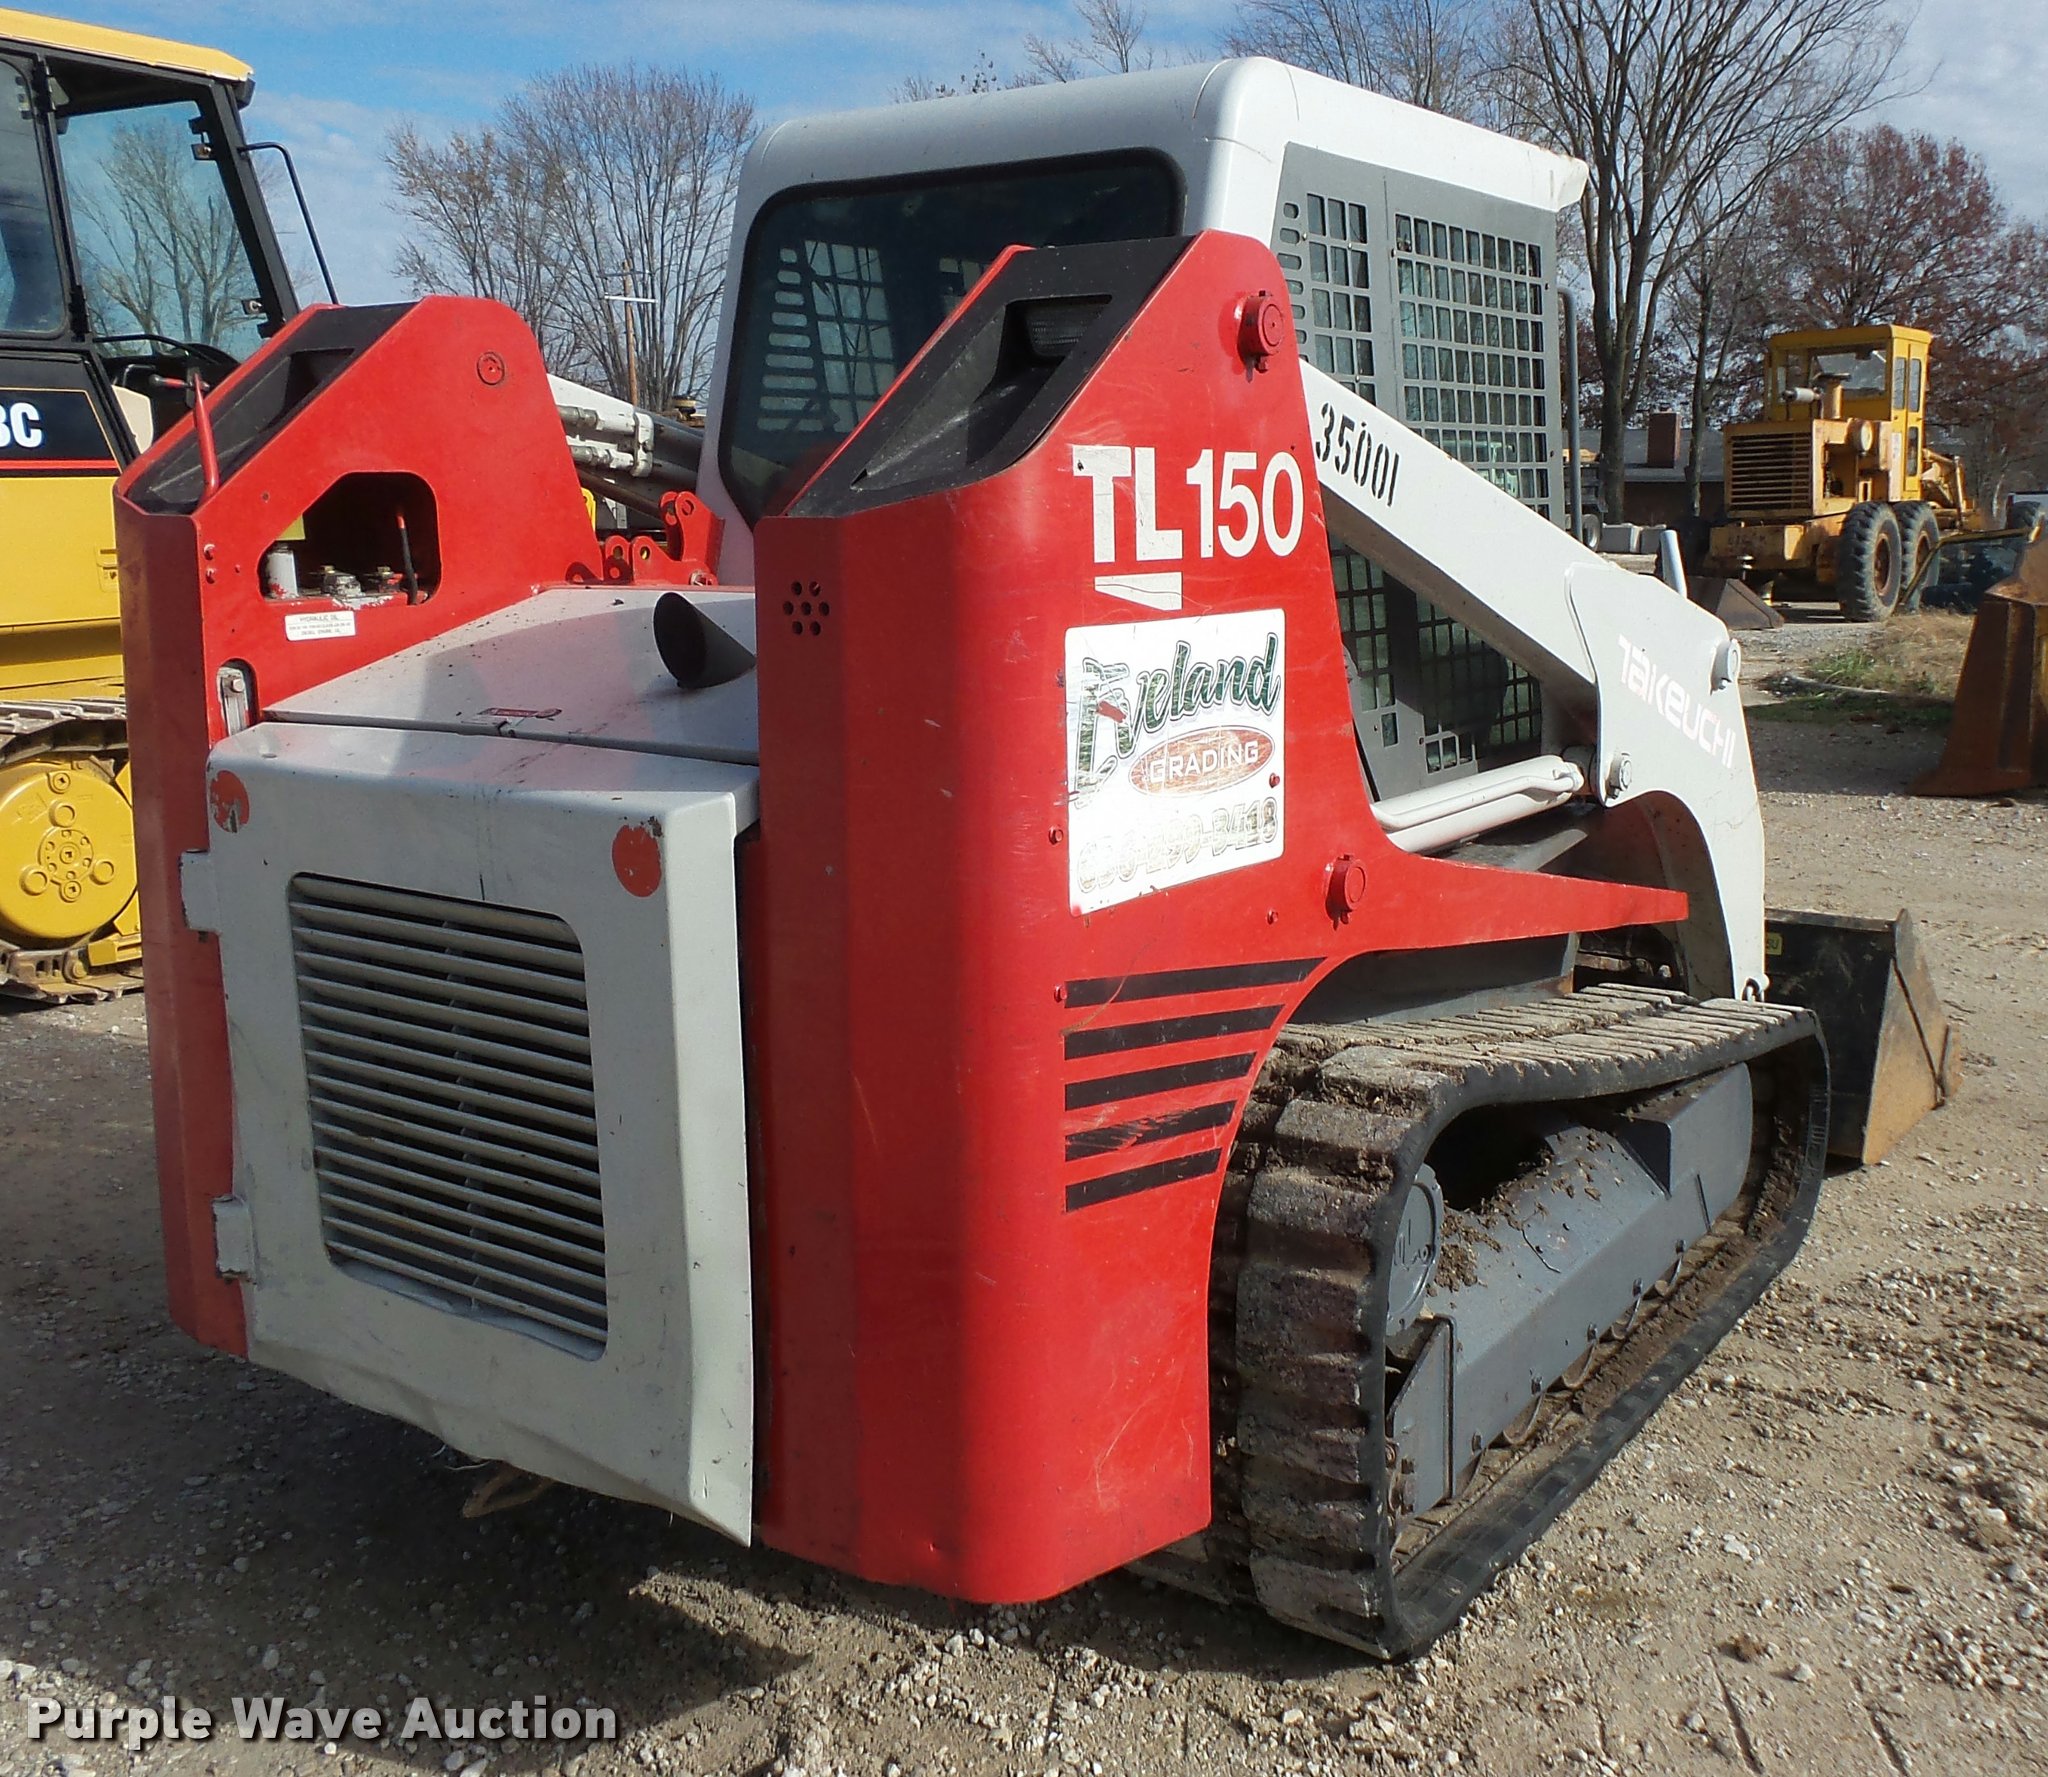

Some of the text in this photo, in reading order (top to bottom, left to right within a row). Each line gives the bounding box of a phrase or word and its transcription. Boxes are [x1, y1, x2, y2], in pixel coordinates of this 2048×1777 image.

[1072, 445, 1304, 562] TL 150
[1147, 739, 1260, 784] GRADING
